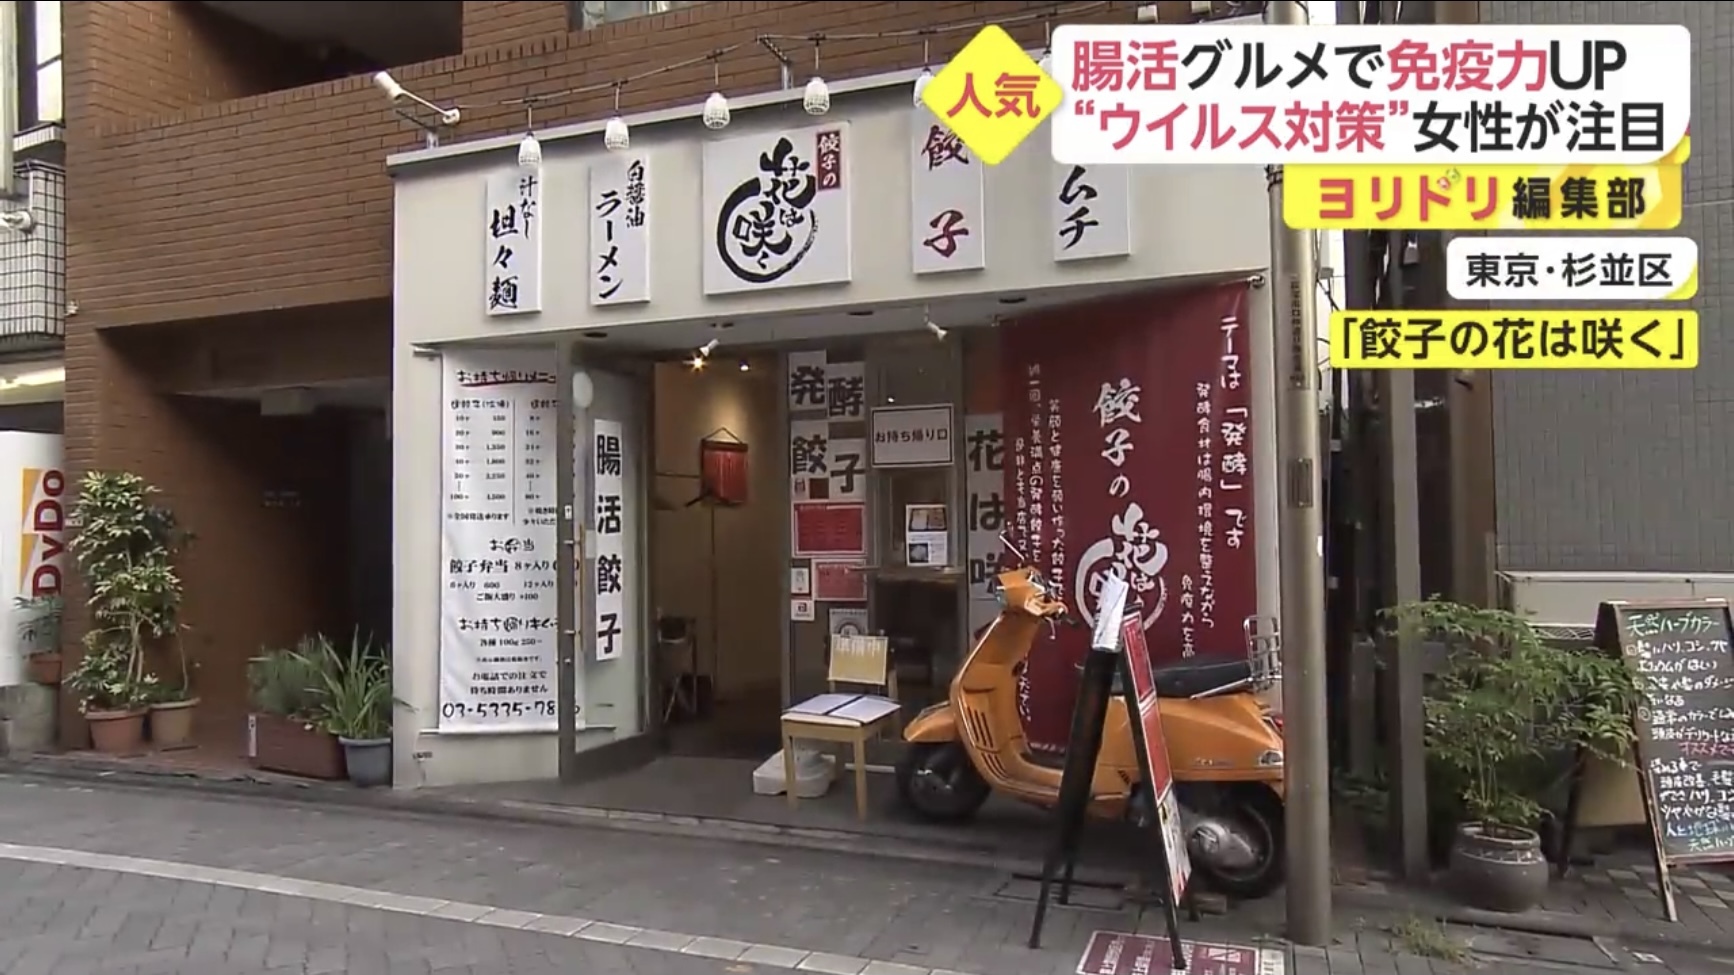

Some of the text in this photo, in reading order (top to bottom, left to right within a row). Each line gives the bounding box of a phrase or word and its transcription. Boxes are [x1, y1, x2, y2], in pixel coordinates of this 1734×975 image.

[733, 137, 818, 270] 花は咲く
[819, 134, 839, 188] 餃子の
[921, 125, 970, 258] 餃子
[520, 175, 538, 239] 汁なし
[595, 190, 623, 299] ラーメン
[791, 364, 864, 418] 発酵
[792, 434, 866, 494] 餃子
[874, 427, 949, 444] お持ち帰り口
[1092, 377, 1142, 498] 餃子の
[596, 433, 622, 654] 腸活餃子
